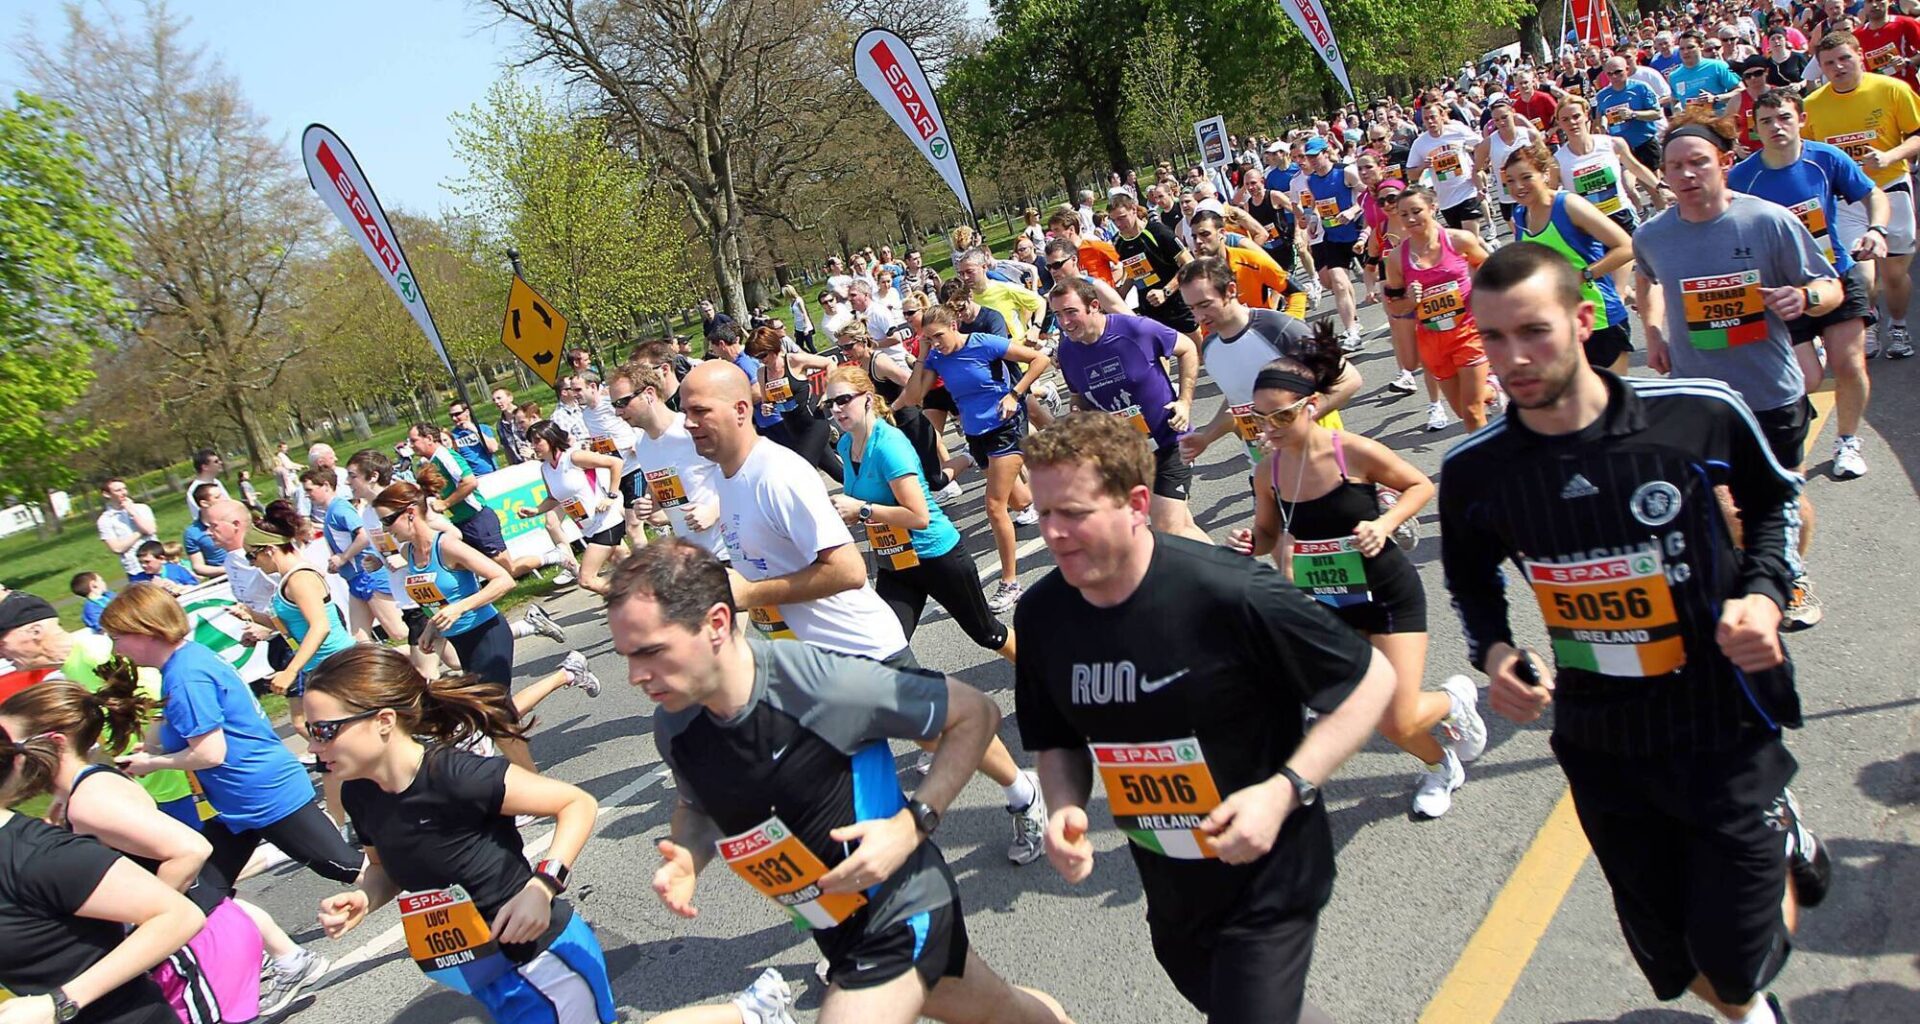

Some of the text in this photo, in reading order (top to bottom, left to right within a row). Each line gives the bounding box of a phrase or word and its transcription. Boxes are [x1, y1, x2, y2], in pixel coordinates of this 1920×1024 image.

[885, 64, 934, 137] SPAR
[1835, 133, 1865, 143] SPAR
[336, 172, 396, 271] SPAR
[1696, 275, 1742, 289] SPAR
[1697, 287, 1746, 302] BERNARD
[1423, 294, 1456, 314] 5046
[1703, 301, 1745, 319] 2962
[1710, 318, 1741, 329] MAYO
[648, 470, 669, 480] SPAR
[1301, 542, 1340, 553] SPAR
[1311, 556, 1335, 567] RITA
[1305, 567, 1349, 585] 11428
[1551, 563, 1629, 582] SPAR
[412, 586, 435, 600] 5141
[1313, 585, 1348, 595] DUBLIN
[1553, 587, 1652, 622] 5056
[1574, 629, 1650, 644] IRELAND
[1072, 660, 1136, 704] RUN
[1112, 749, 1175, 763] SPAR
[1119, 773, 1198, 805] 5016
[1138, 814, 1202, 830] IRELAND
[728, 834, 770, 856] SPAR
[745, 851, 805, 888] 5131
[409, 892, 452, 910] SPAR
[424, 908, 450, 928] LUCY
[425, 927, 468, 955] 1660
[435, 949, 475, 969] DUBLIN
